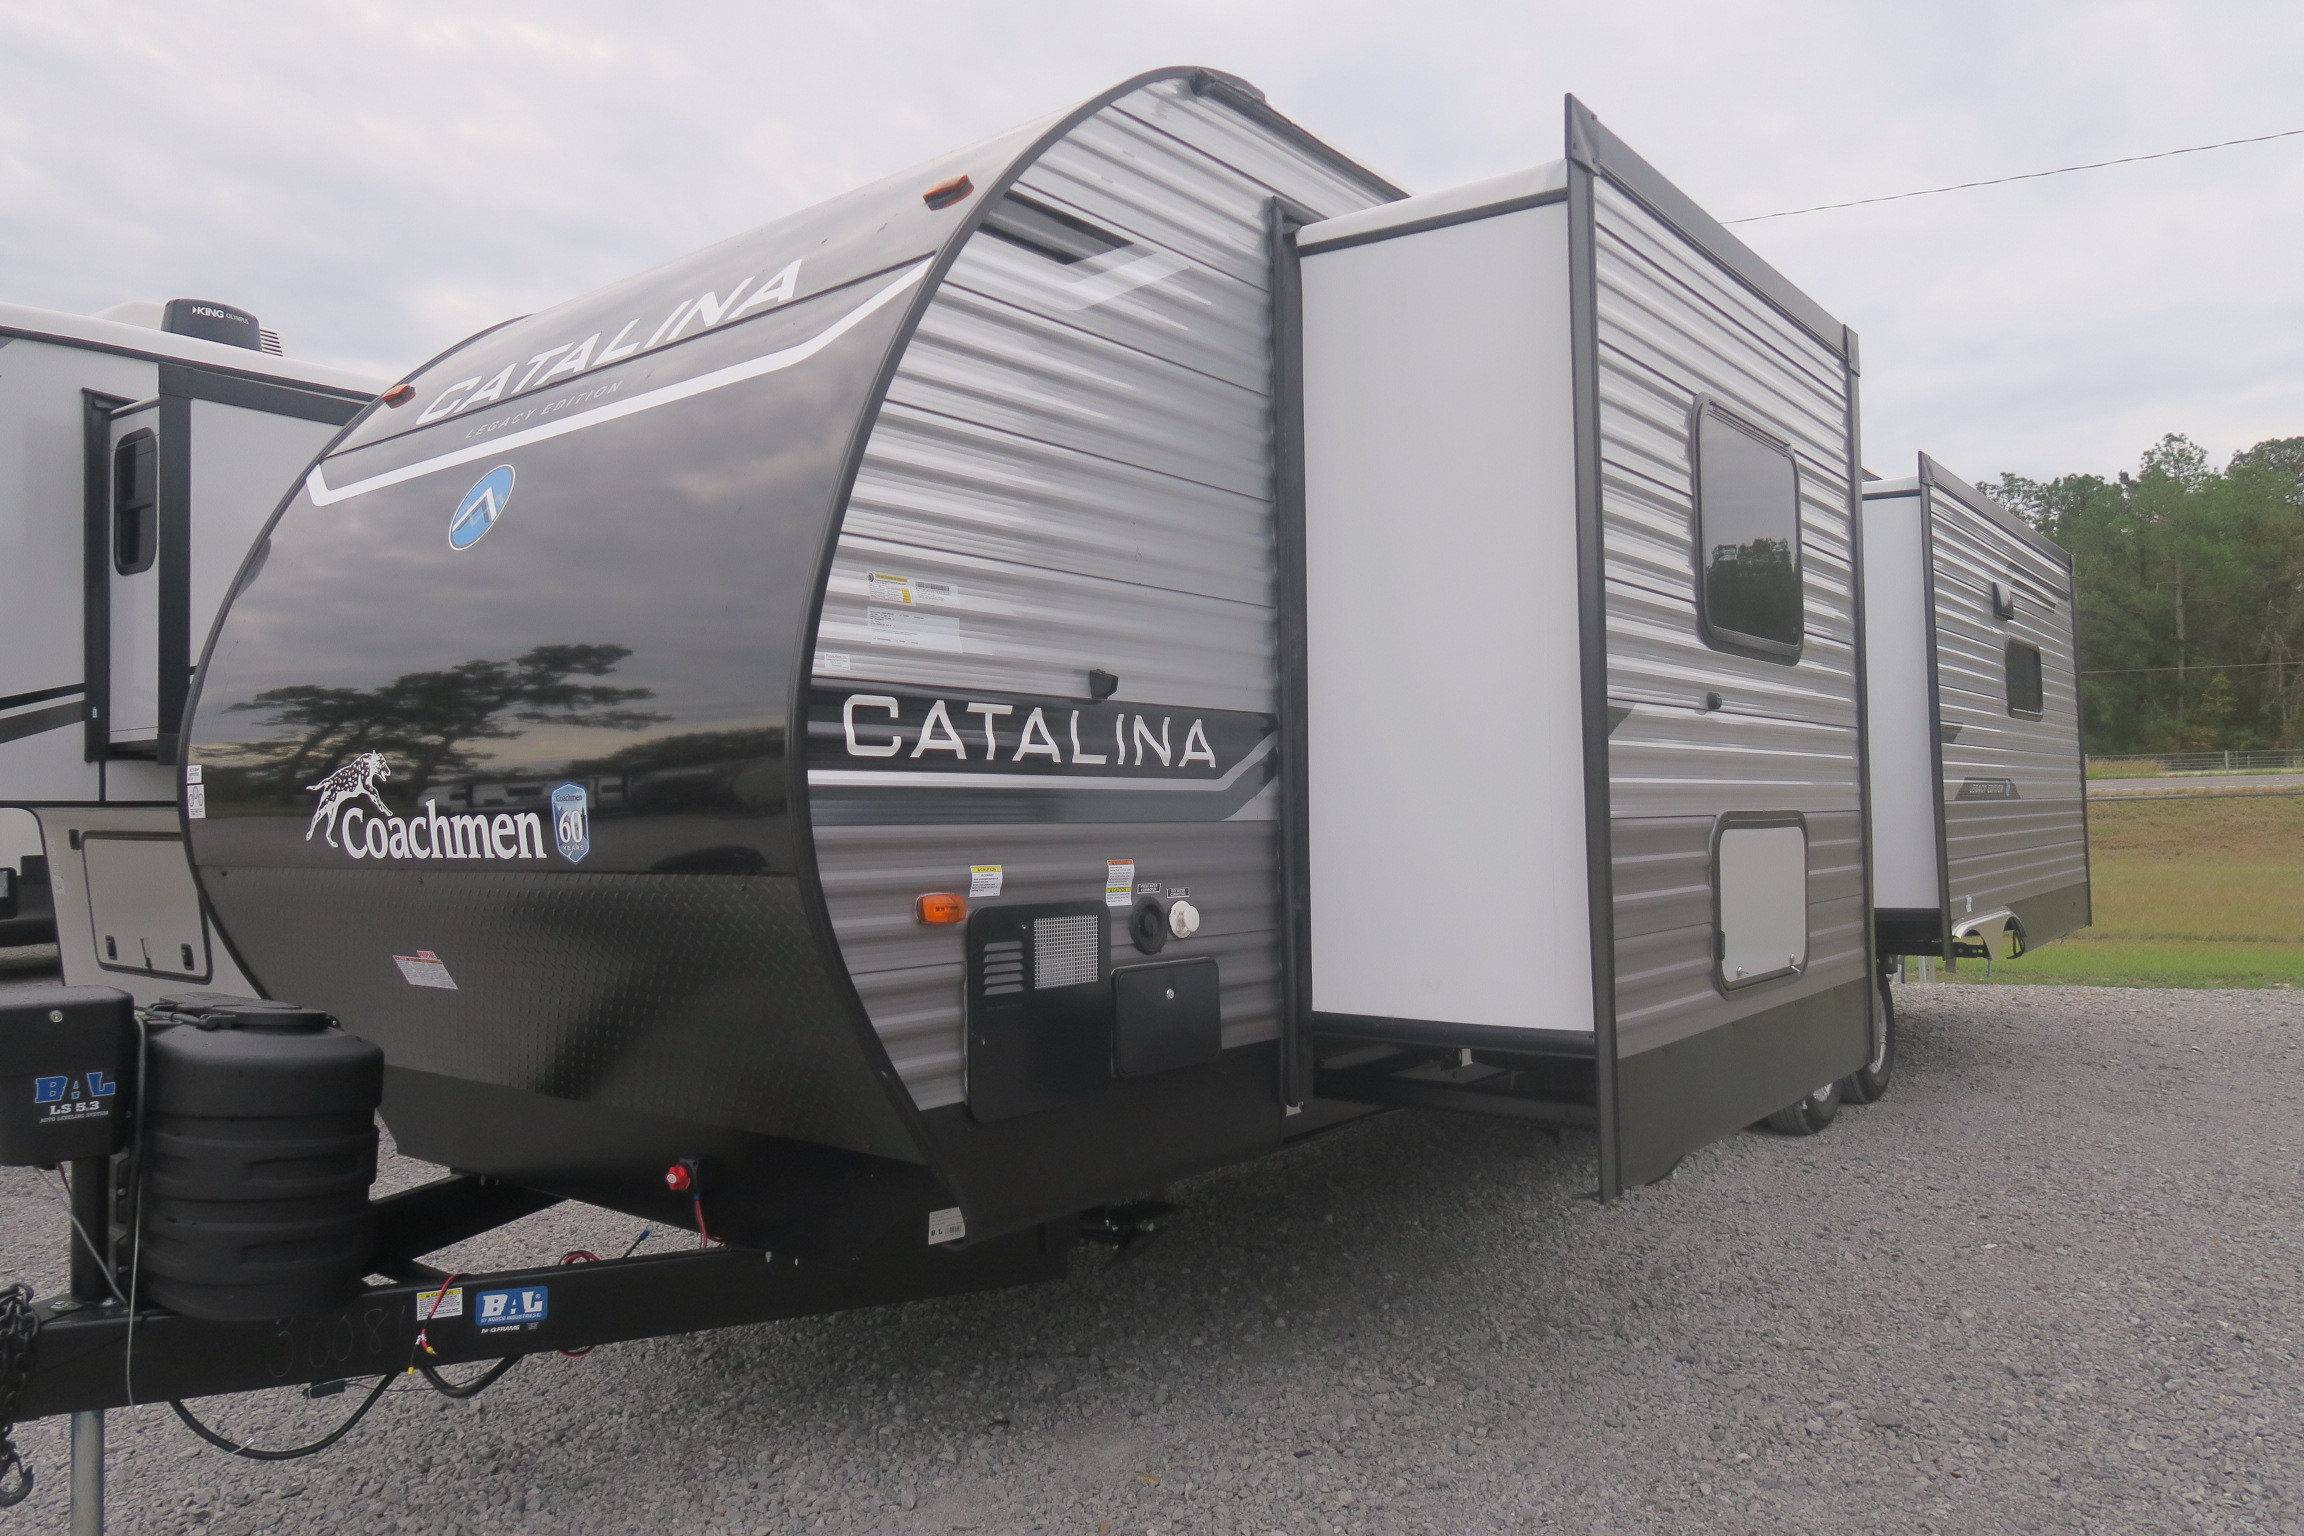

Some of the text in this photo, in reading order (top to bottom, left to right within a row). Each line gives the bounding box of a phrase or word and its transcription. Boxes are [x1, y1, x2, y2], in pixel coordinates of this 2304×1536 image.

[197, 306, 249, 325] KING OLYMPUS
[415, 258, 803, 426] CATALINA
[464, 380, 625, 440] LEGACY EDITION
[843, 693, 1217, 769] CATALINA
[342, 799, 547, 860] Coachmen
[558, 810, 583, 843] 60
[34, 1071, 117, 1104] BAL
[40, 1116, 56, 1124] AUTO
[86, 1110, 109, 1118] SYSTEM
[49, 1100, 101, 1116] LS 5.3
[506, 1312, 536, 1320] INDUSTRIES
